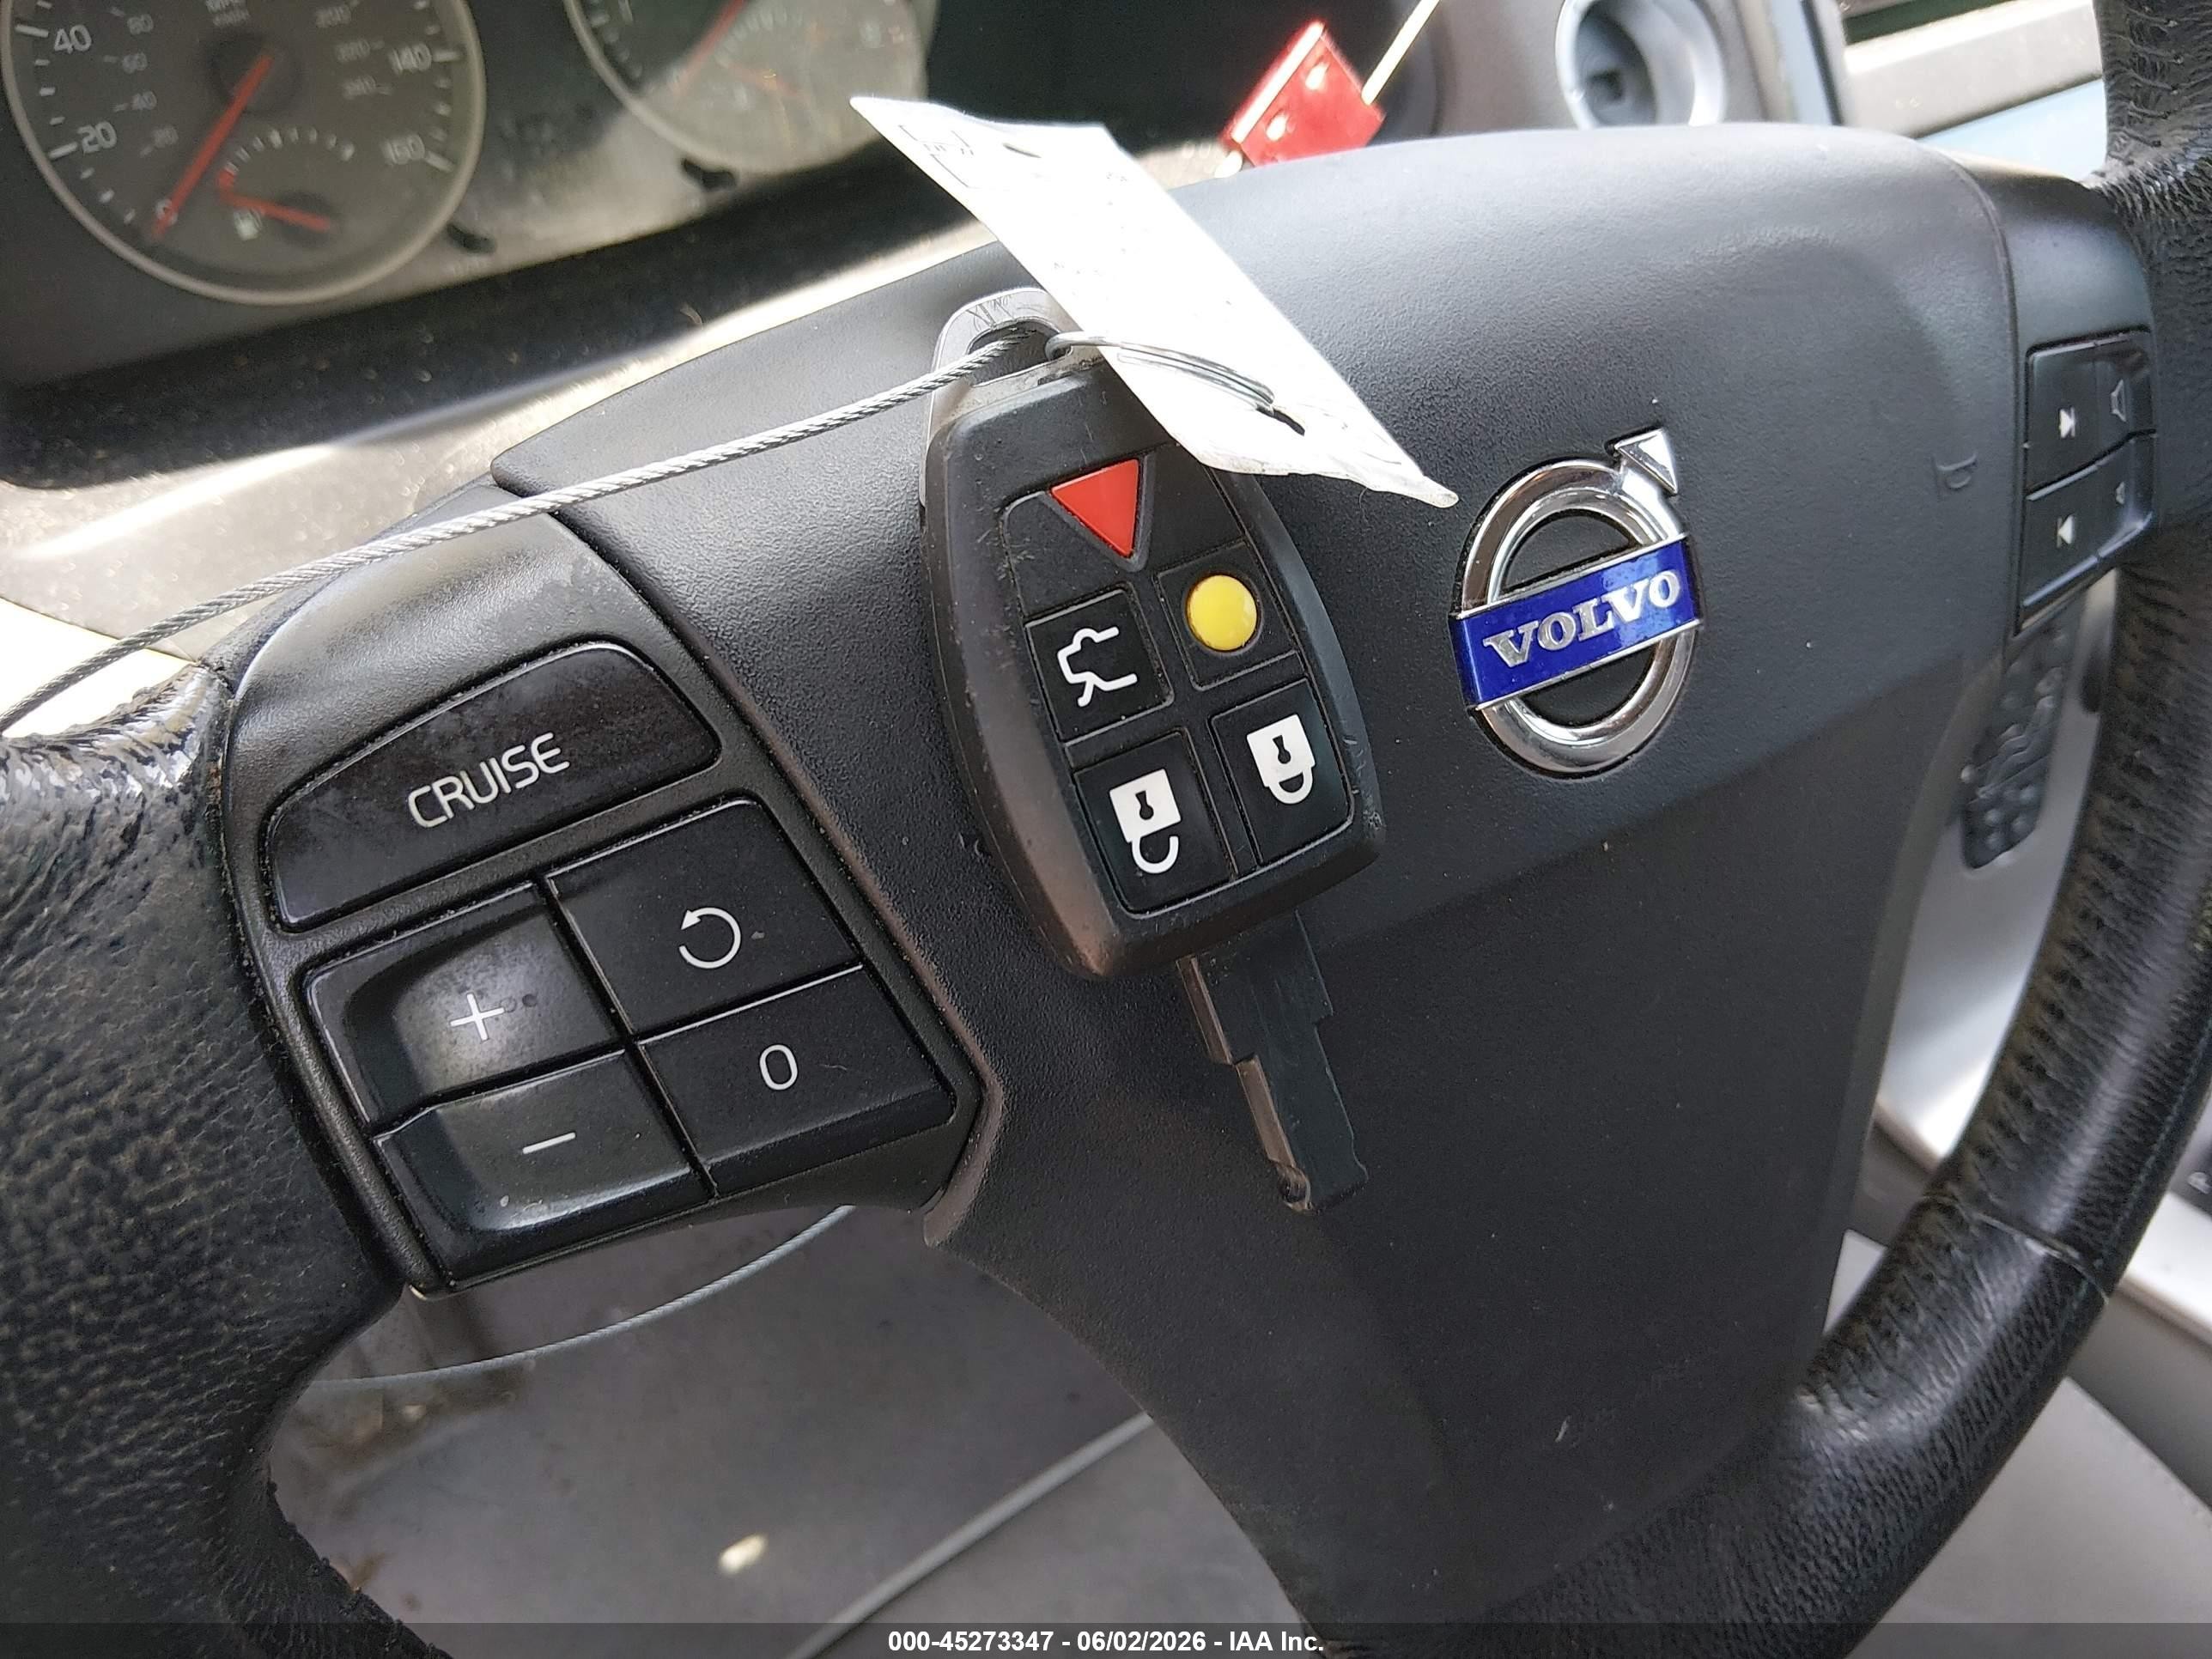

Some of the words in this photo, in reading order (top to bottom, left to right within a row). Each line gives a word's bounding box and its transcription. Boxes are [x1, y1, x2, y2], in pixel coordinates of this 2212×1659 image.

[53, 23, 92, 54] 40
[77, 120, 118, 154] 20
[1483, 569, 1680, 667] VOLVO
[408, 732, 569, 828] CRUISE
[759, 1045, 799, 1091] 0
